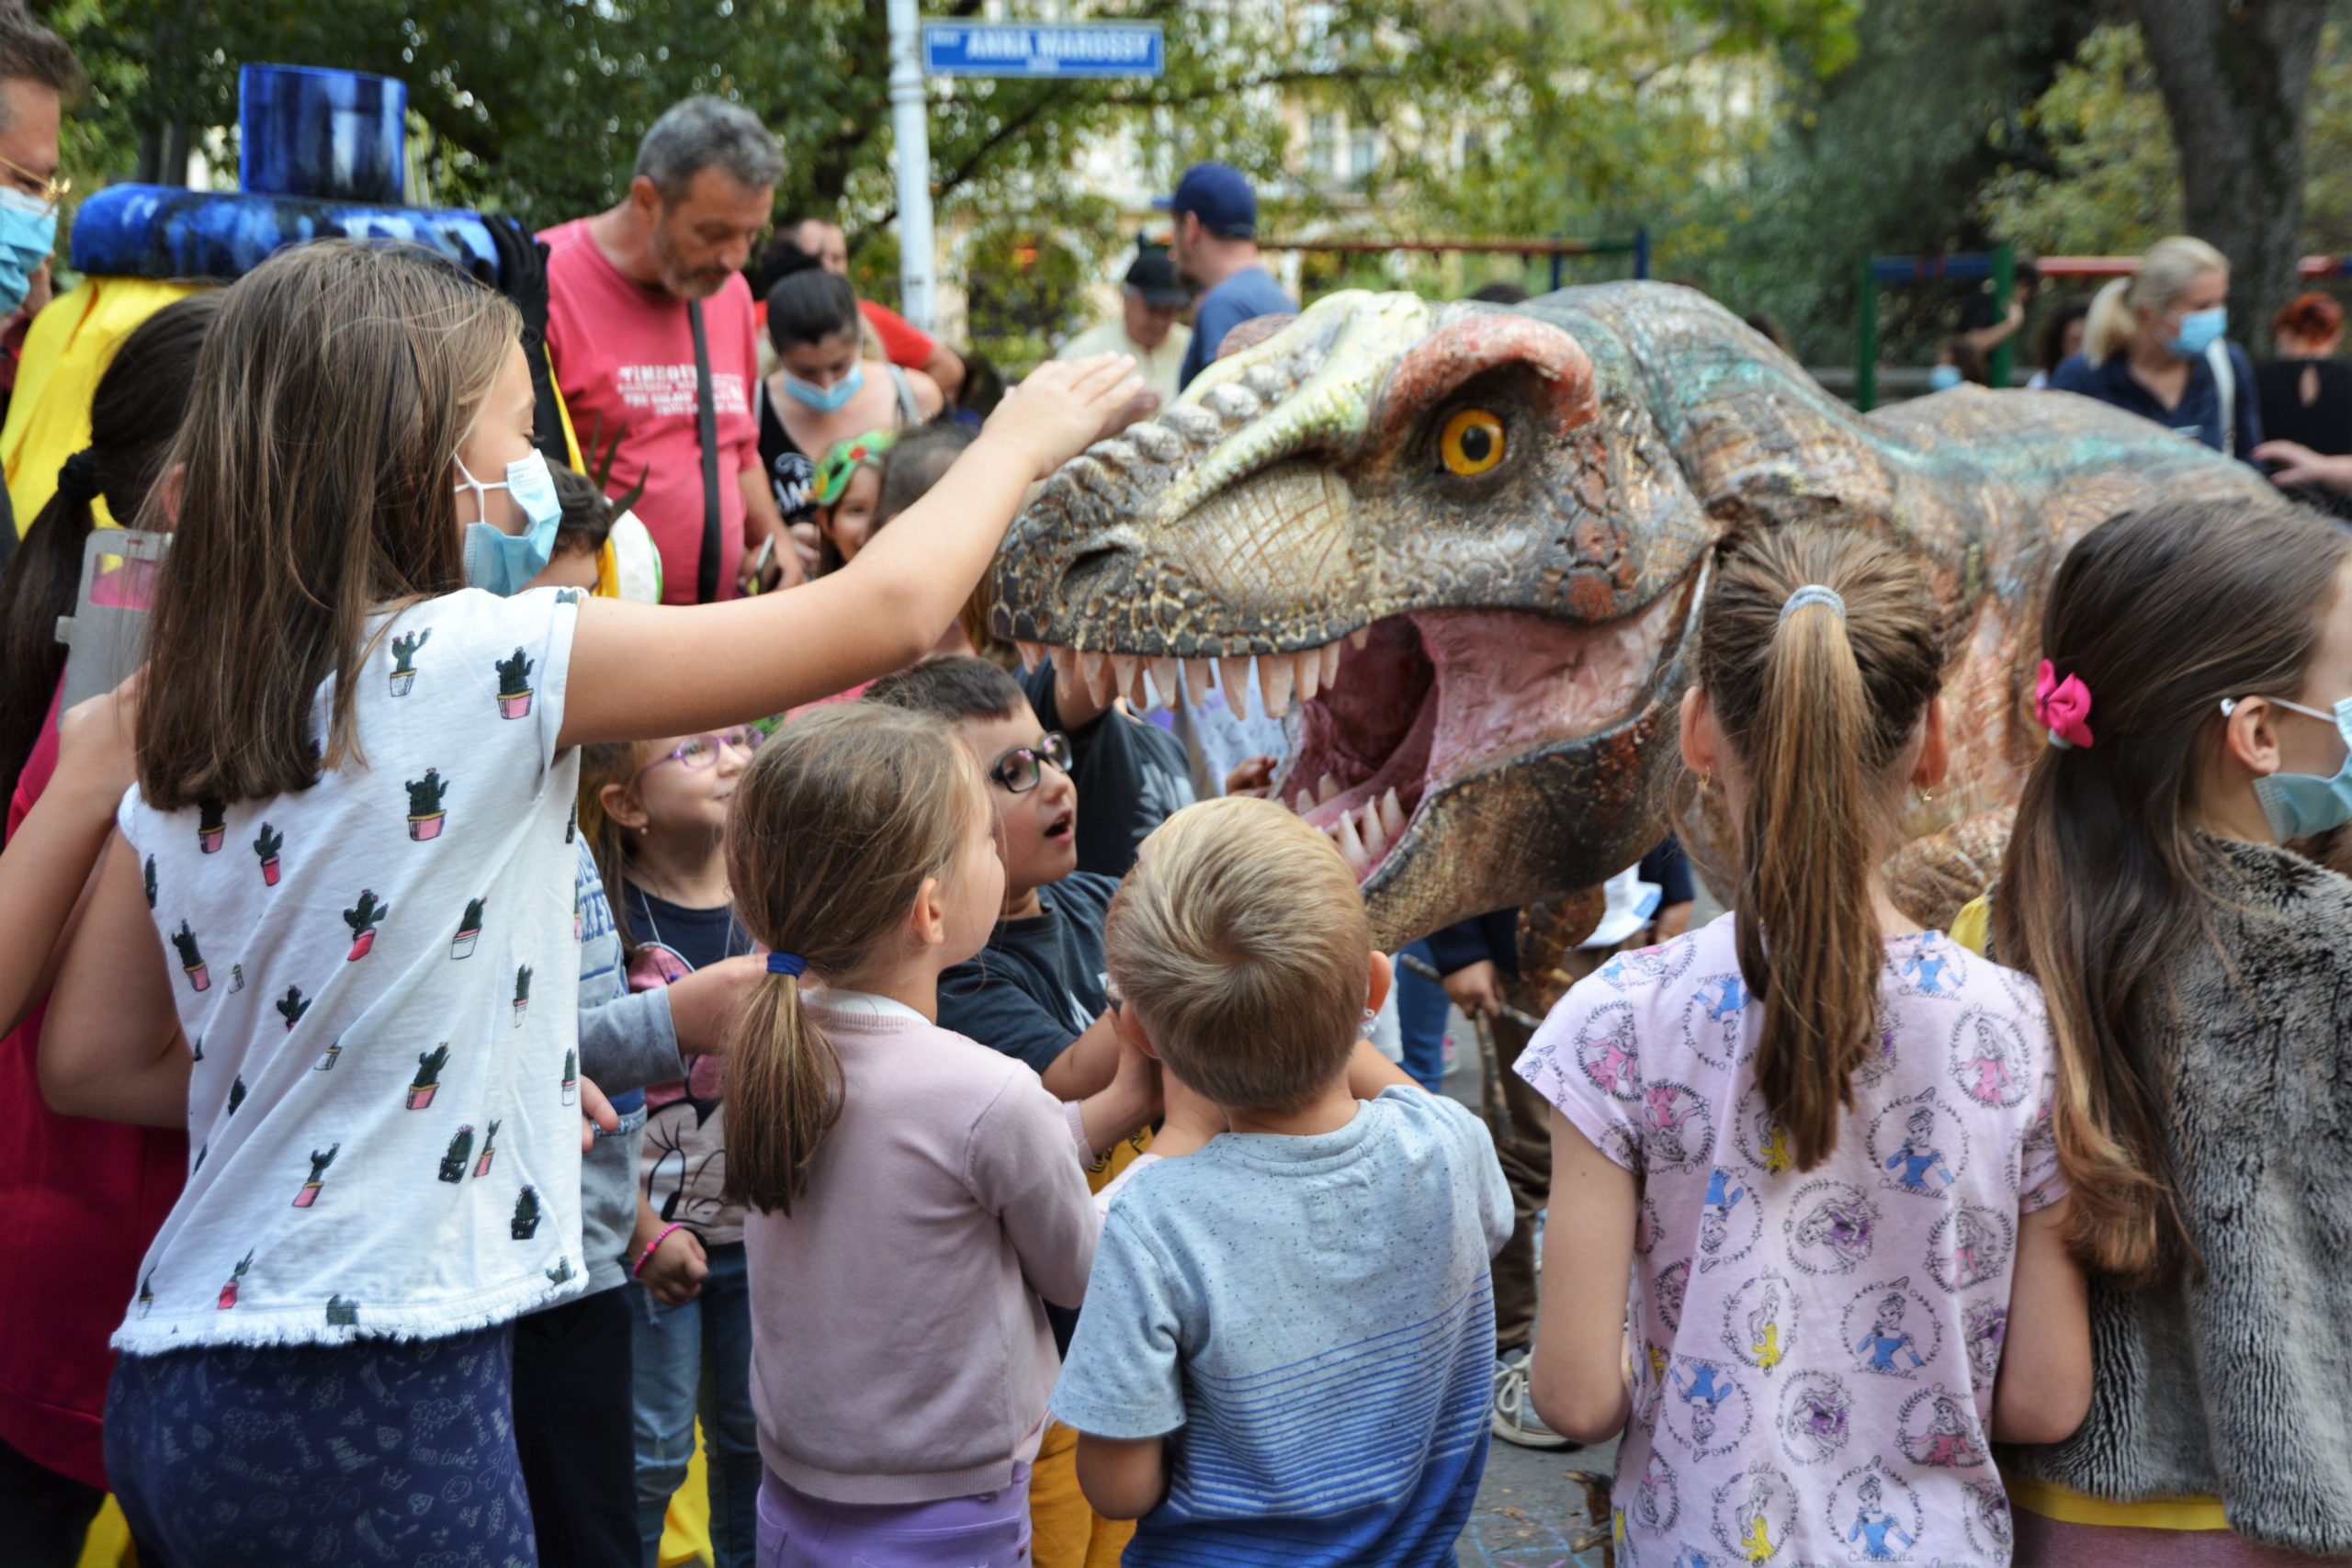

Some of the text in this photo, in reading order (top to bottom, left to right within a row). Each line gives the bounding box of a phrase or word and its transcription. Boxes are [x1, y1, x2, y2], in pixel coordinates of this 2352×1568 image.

[1898, 984, 1962, 1002] Cinderella
[1878, 1178, 1949, 1201] Cinderella
[1851, 1360, 1918, 1382] Cinderella
[1748, 1459, 1779, 1475] Belle
[1848, 1550, 1917, 1563] Cinderella
